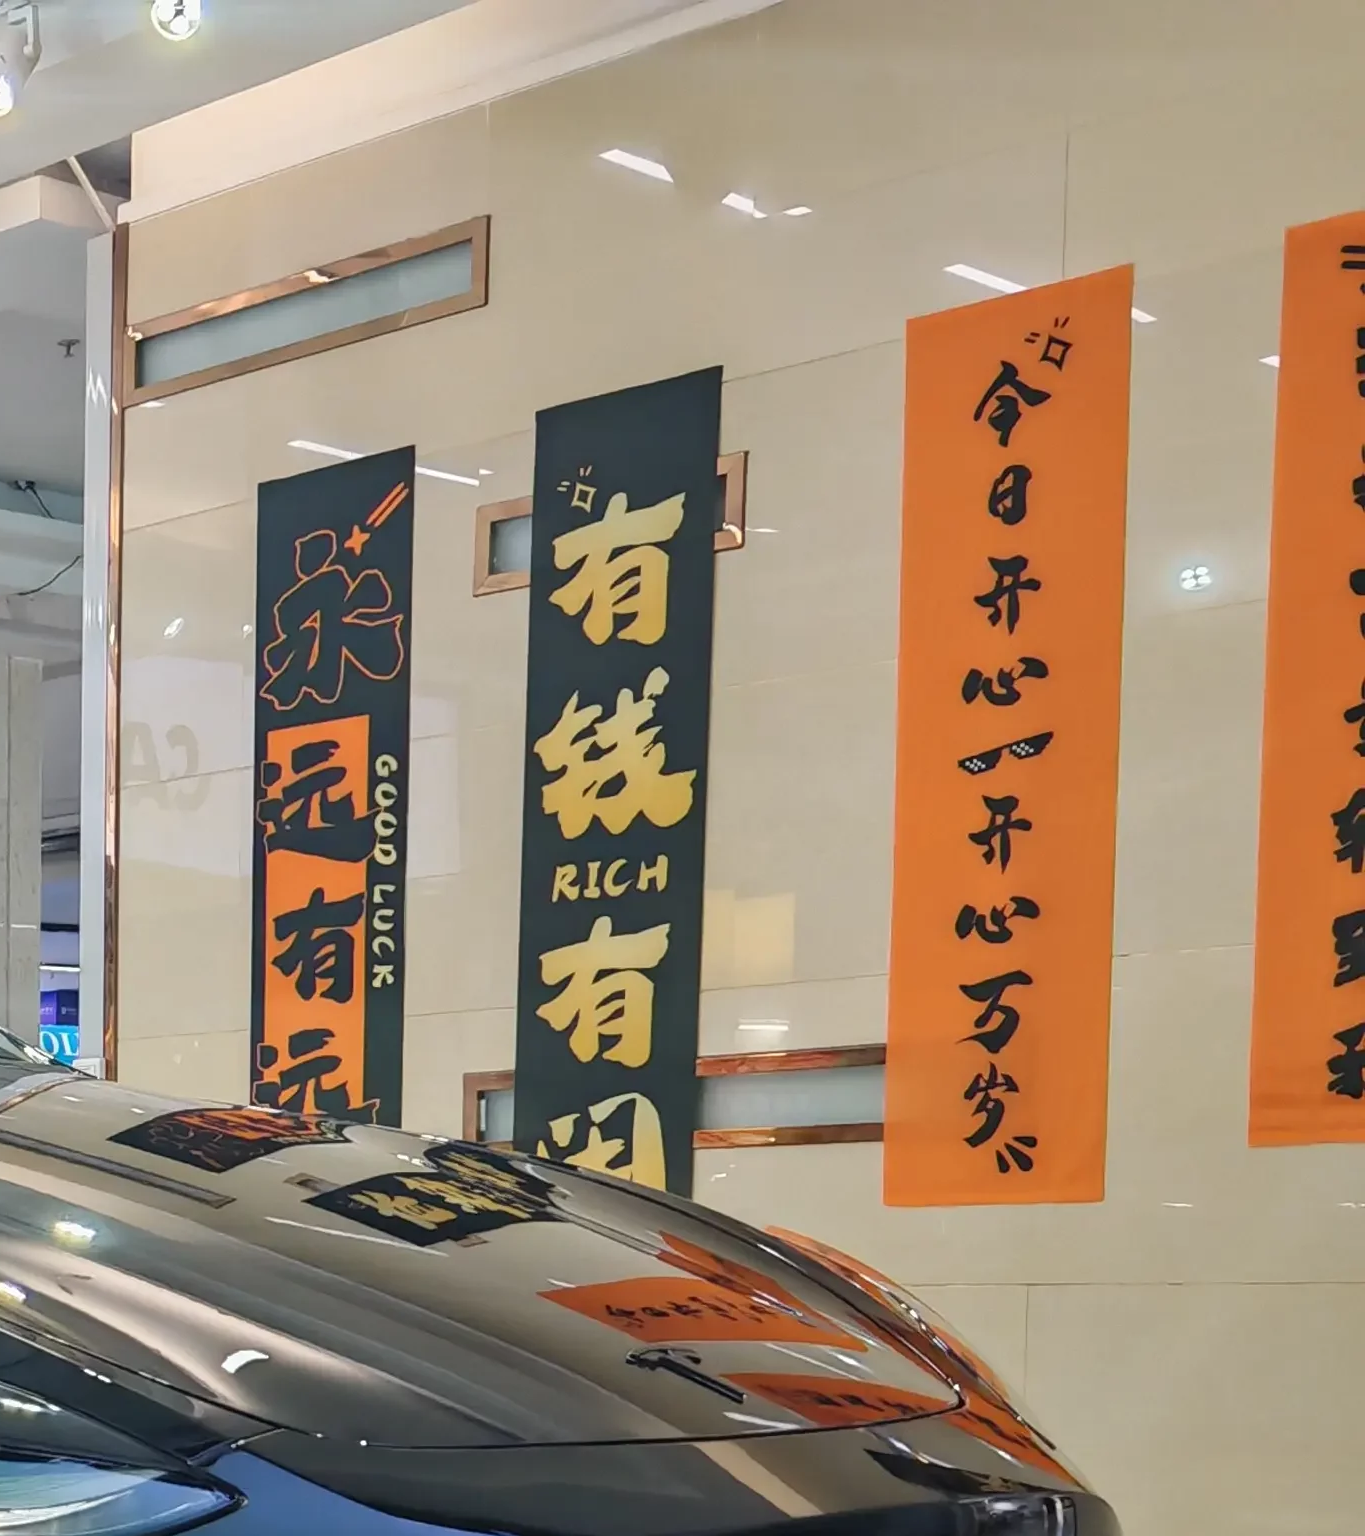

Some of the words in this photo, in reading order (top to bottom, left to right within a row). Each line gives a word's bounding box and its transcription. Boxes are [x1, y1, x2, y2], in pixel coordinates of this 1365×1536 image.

[372, 753, 400, 867] GOOD
[551, 855, 669, 903] RICH
[371, 883, 397, 990] LUCK
